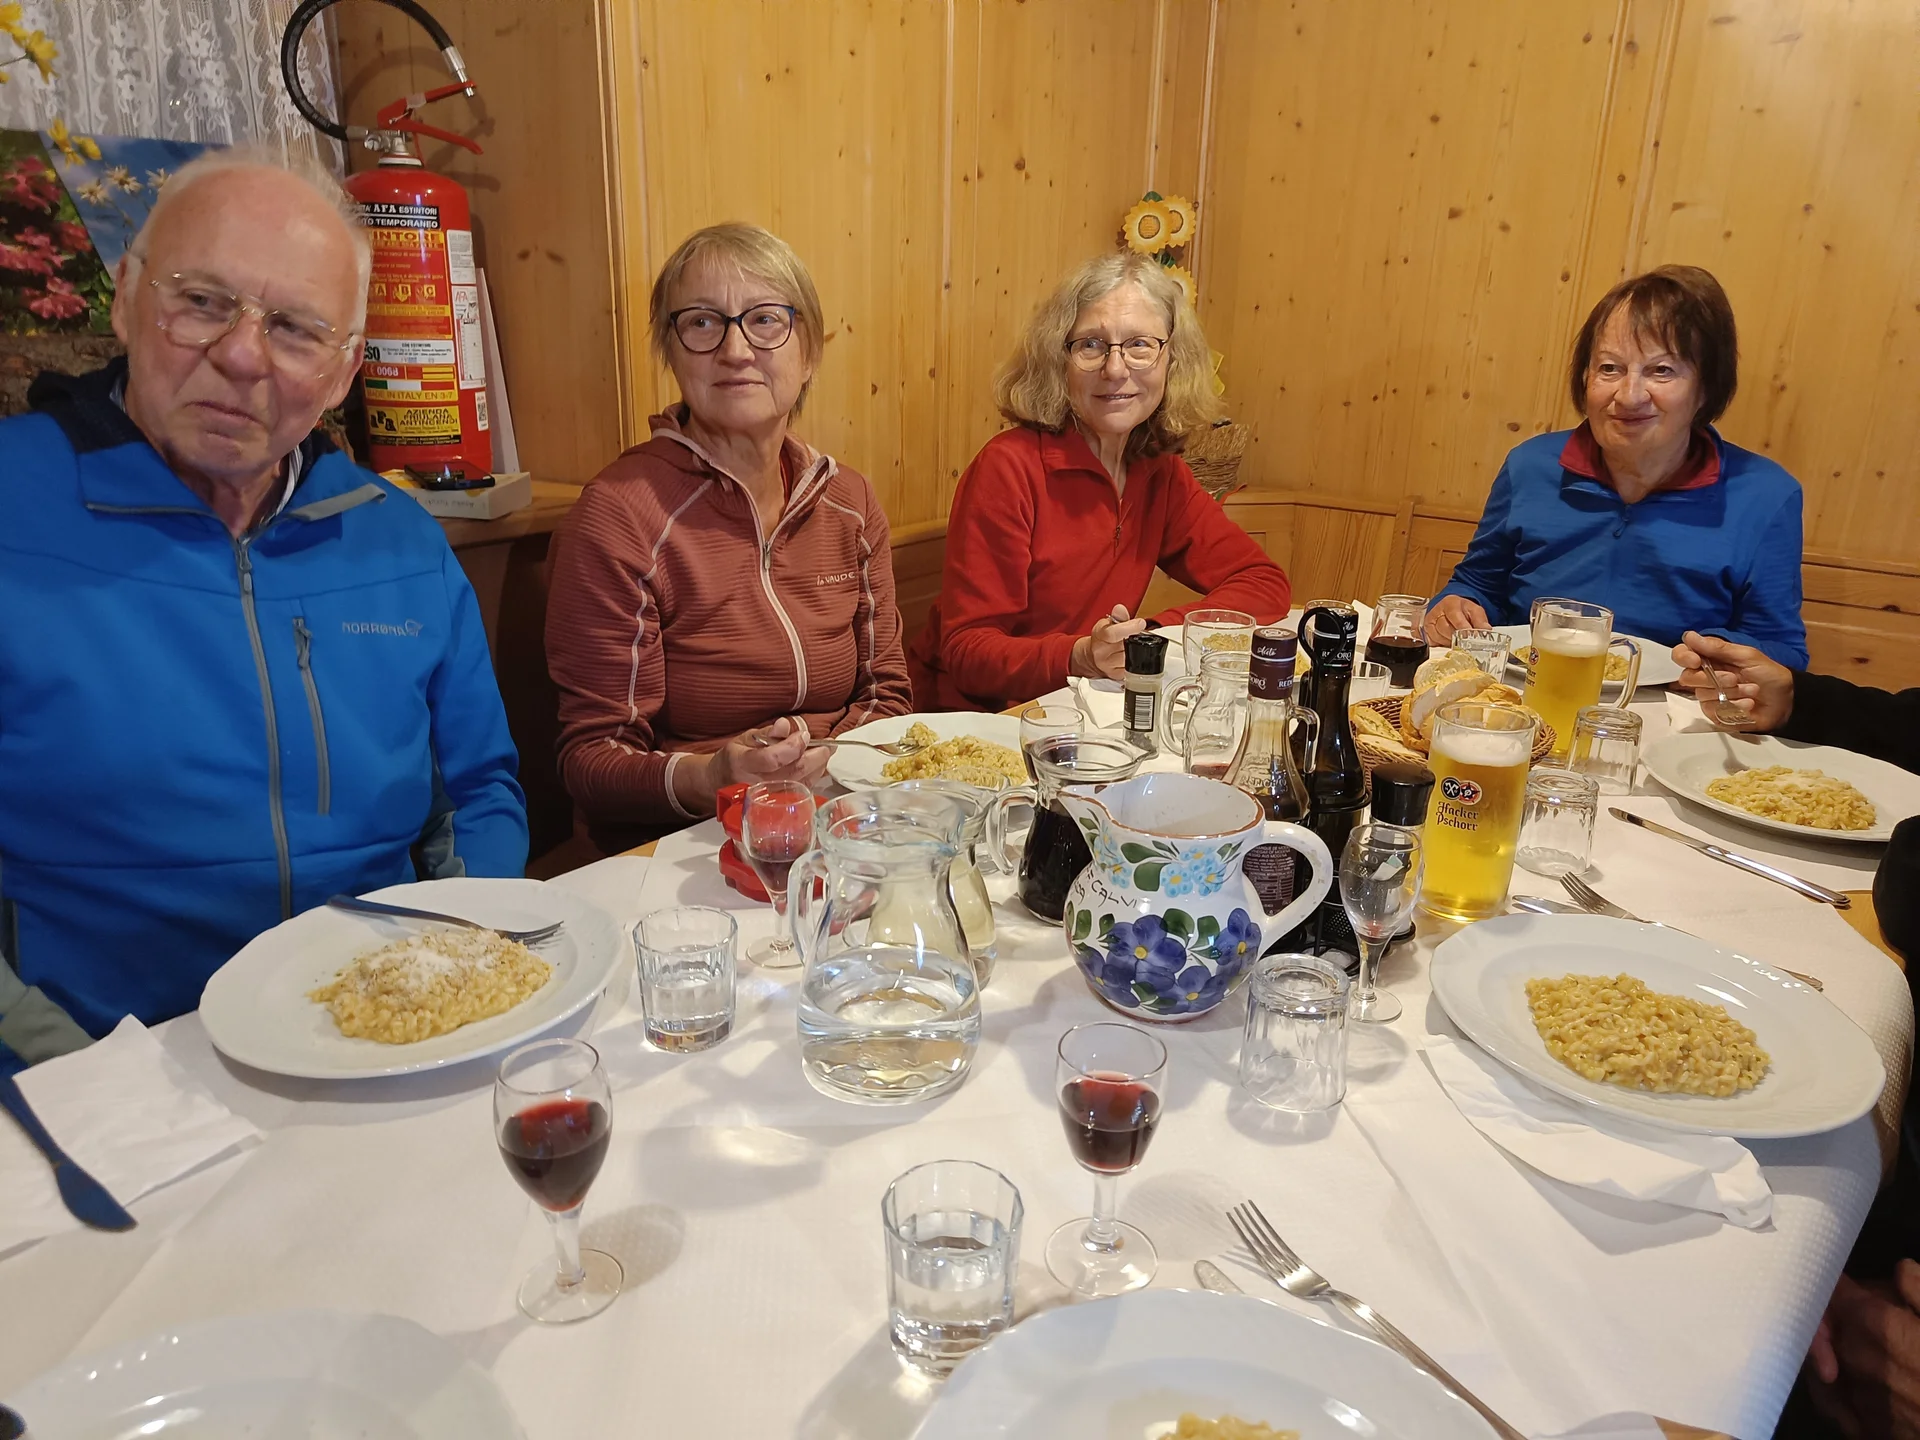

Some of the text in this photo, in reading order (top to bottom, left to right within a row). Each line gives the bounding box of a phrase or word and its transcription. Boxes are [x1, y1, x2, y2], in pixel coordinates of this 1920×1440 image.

[373, 203, 396, 213] AFA
[398, 206, 438, 215] ESTINTORI
[375, 218, 438, 229] TEMPORANEO
[373, 231, 439, 241] INTORE
[386, 391, 395, 399] IN
[398, 391, 422, 400] ITALY
[425, 391, 438, 399] EN
[1436, 812, 1478, 831] Pschorr
